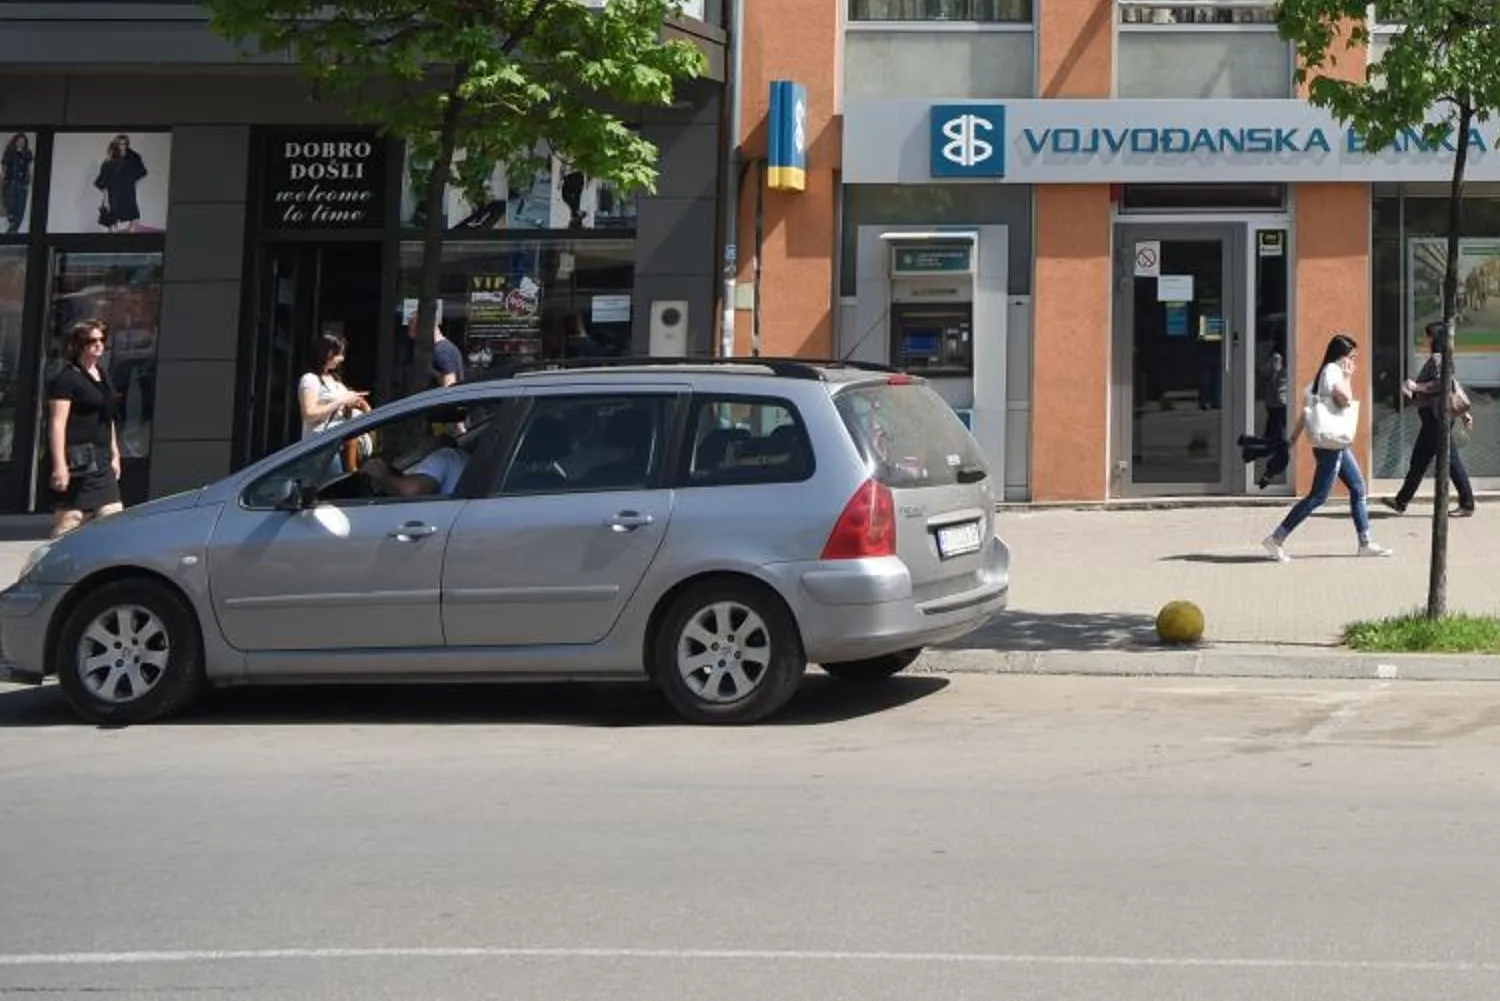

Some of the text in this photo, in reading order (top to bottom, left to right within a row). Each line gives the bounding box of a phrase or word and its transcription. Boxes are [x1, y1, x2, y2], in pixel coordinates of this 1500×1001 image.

[1022, 121, 1487, 153] VOJVOĐANSKA BNKA
[285, 142, 371, 157] DOBRO
[289, 159, 364, 179] DOŠLI
[274, 184, 371, 202] welcome
[283, 204, 364, 221] to time
